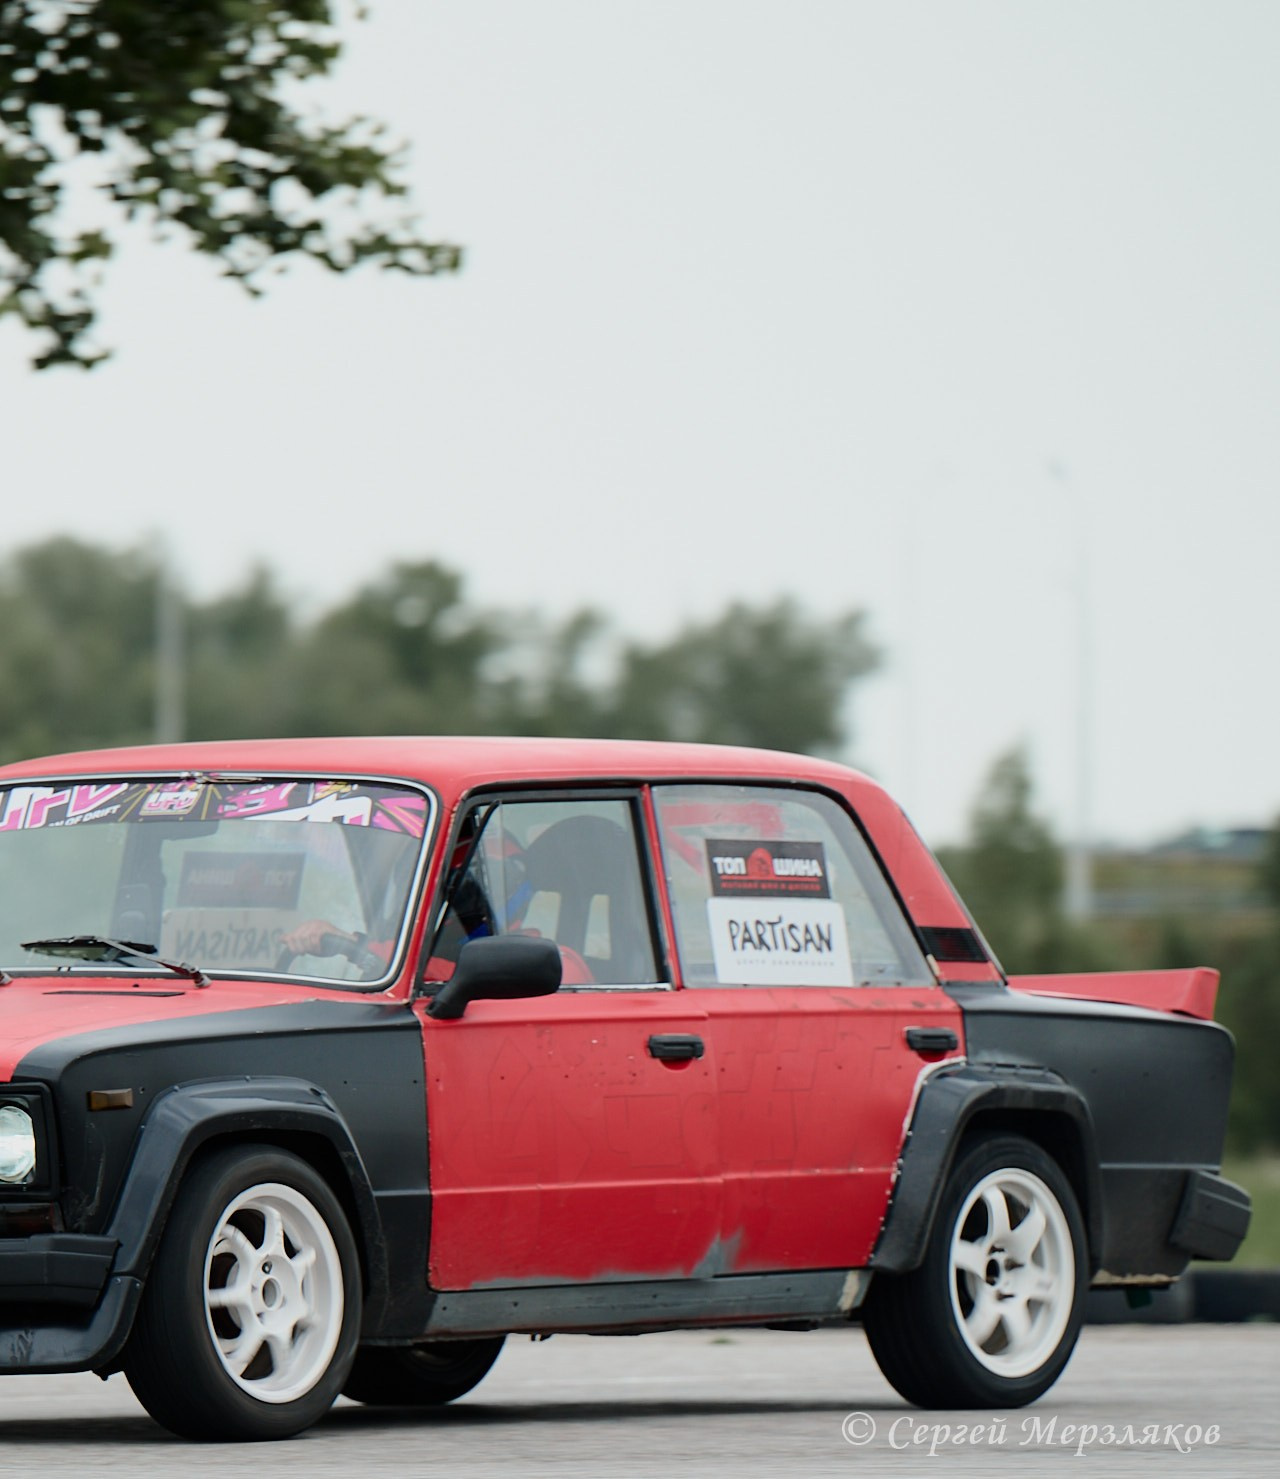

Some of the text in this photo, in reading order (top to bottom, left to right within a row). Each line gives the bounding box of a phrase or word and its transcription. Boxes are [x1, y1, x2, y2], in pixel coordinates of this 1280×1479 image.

[82, 804, 121, 822] DRIFT
[713, 857, 822, 877] ТОП ШИНА
[728, 915, 832, 953] PARTISAN
